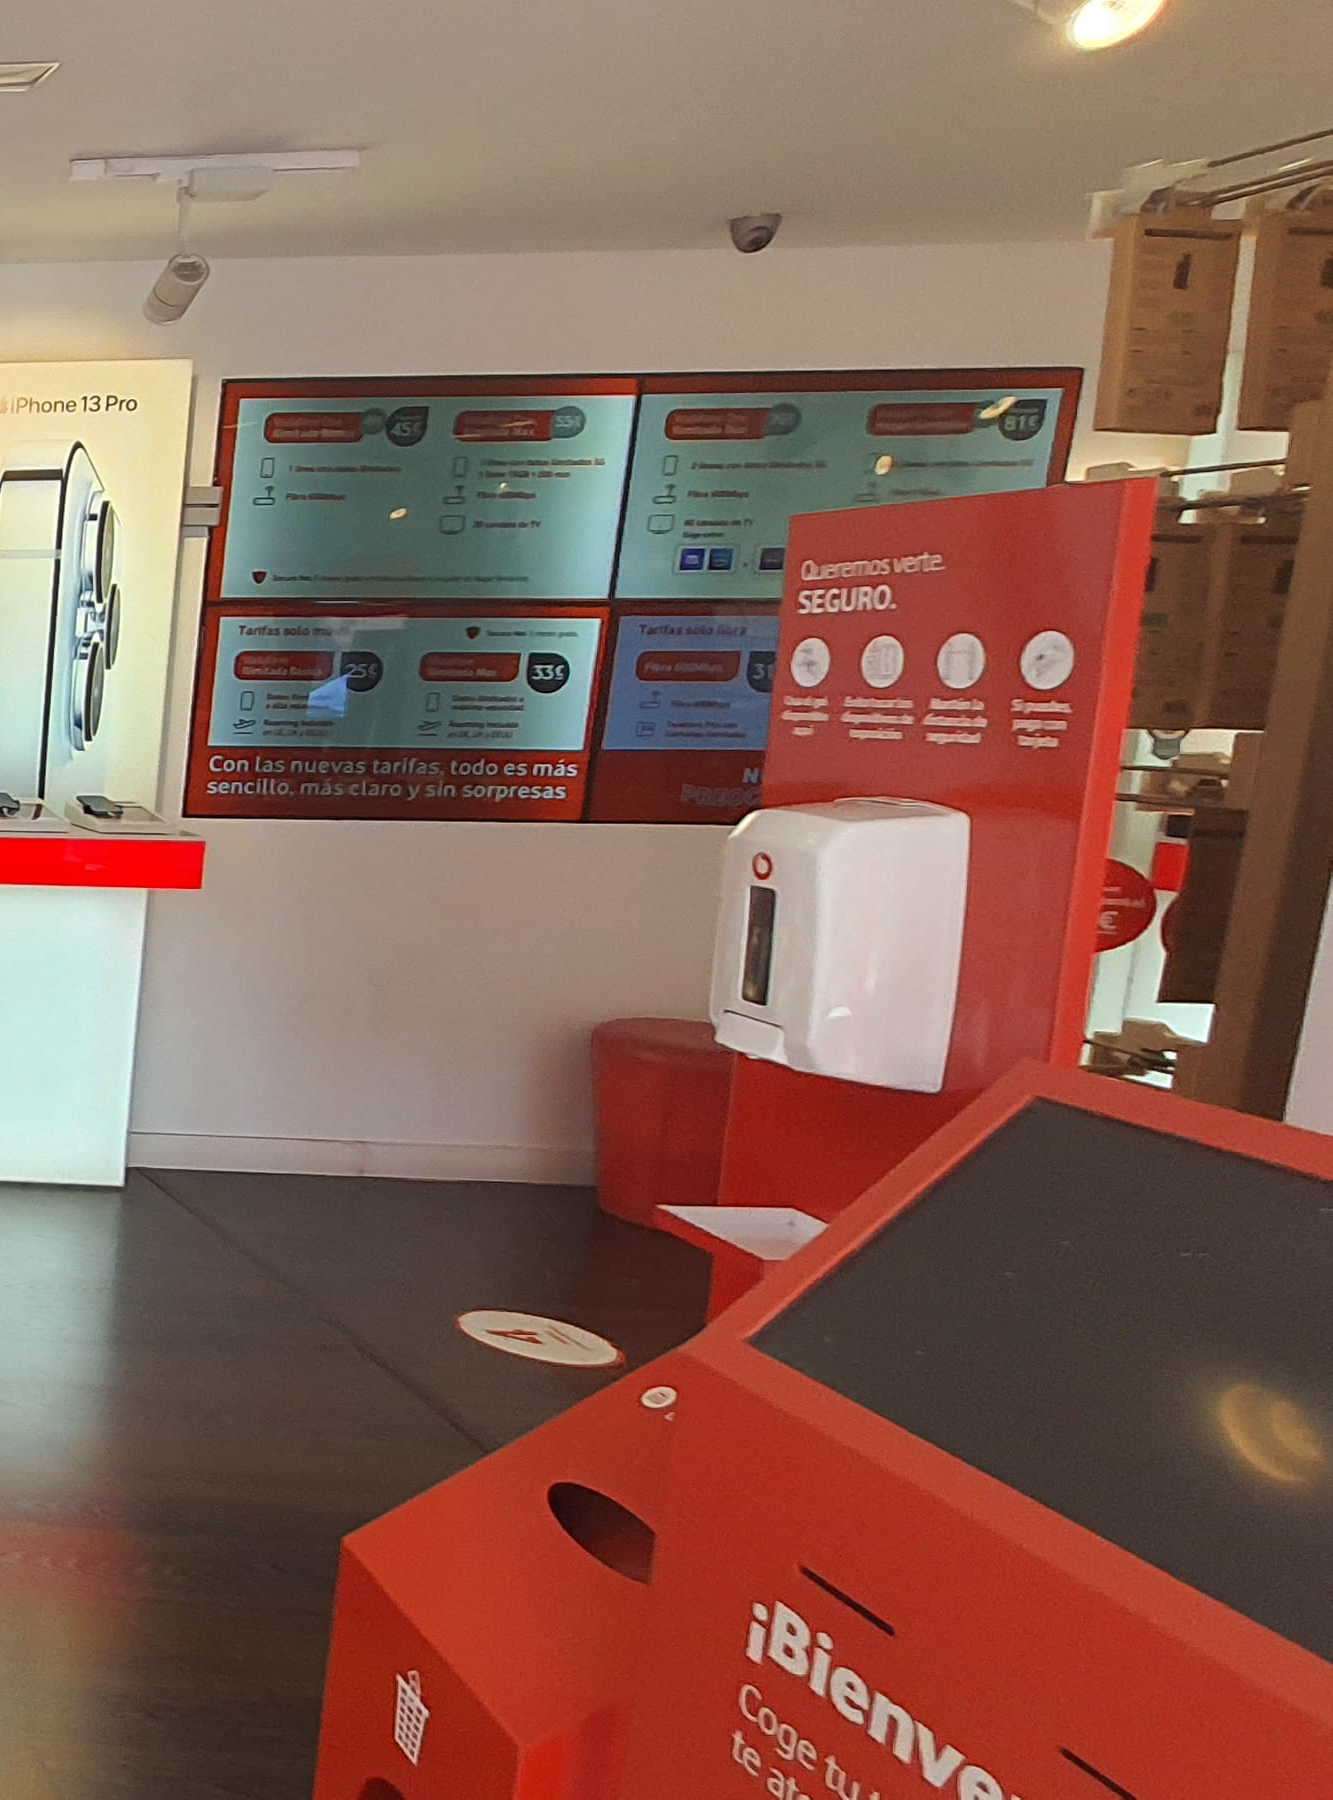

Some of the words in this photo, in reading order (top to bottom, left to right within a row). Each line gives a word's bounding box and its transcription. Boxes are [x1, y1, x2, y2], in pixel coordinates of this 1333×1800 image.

[10, 396, 77, 414] iPhone
[80, 395, 101, 412] 13
[105, 395, 138, 412] Pro
[801, 559, 891, 581] Queremos
[797, 585, 898, 614] SEGURO.
[238, 625, 281, 636] Tarifas
[283, 625, 310, 636] solo
[638, 624, 682, 637] Tarifas
[684, 624, 714, 636] solo
[532, 664, 565, 680] 33€
[208, 755, 251, 773] Con
[254, 757, 286, 774] las
[290, 759, 367, 775] nuevas
[372, 758, 446, 777] tarifas,
[450, 760, 499, 776] todo
[503, 763, 529, 776] es
[532, 759, 579, 778] más
[300, 781, 343, 797] más
[348, 780, 402, 798] claro
[407, 783, 422, 801] y
[425, 781, 456, 797] sin
[461, 783, 568, 803] sorpresas
[746, 1600, 1022, 1800] ¡Bienve
[738, 1683, 819, 1771] Coge
[824, 1755, 862, 1800] tu
[732, 1729, 763, 1777] te
[766, 1767, 812, 1800] at
